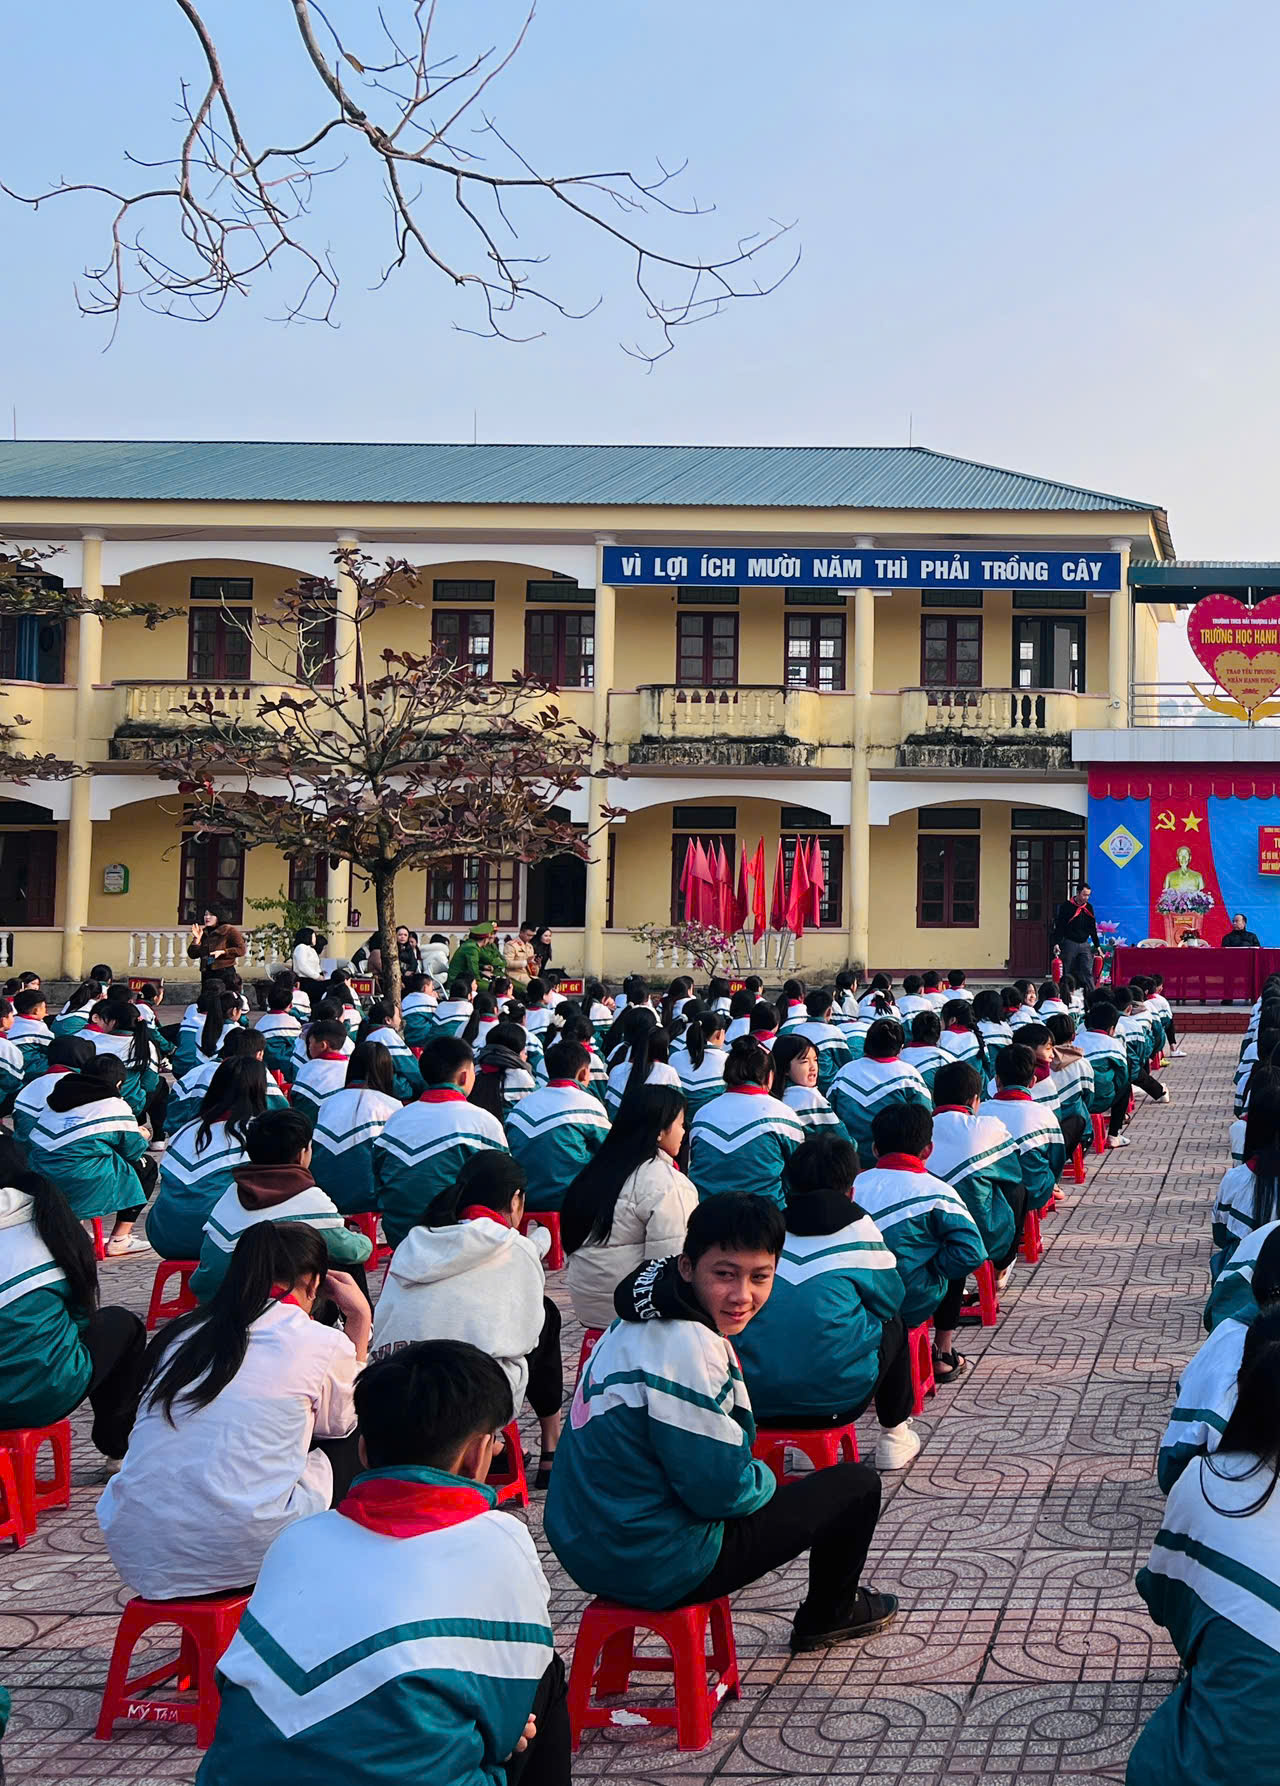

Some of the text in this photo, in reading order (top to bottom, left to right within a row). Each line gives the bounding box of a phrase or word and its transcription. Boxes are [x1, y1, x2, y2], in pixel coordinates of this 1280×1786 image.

[622, 554, 1102, 581] VÌ LỢI ÍCH MƯỜI NĂM THÌ PHẢI TRỒNG CÂY
[1200, 626, 1233, 644] TRƯỜNG
[1235, 629, 1253, 647] HỌC
[1254, 629, 1277, 647] HẠNH
